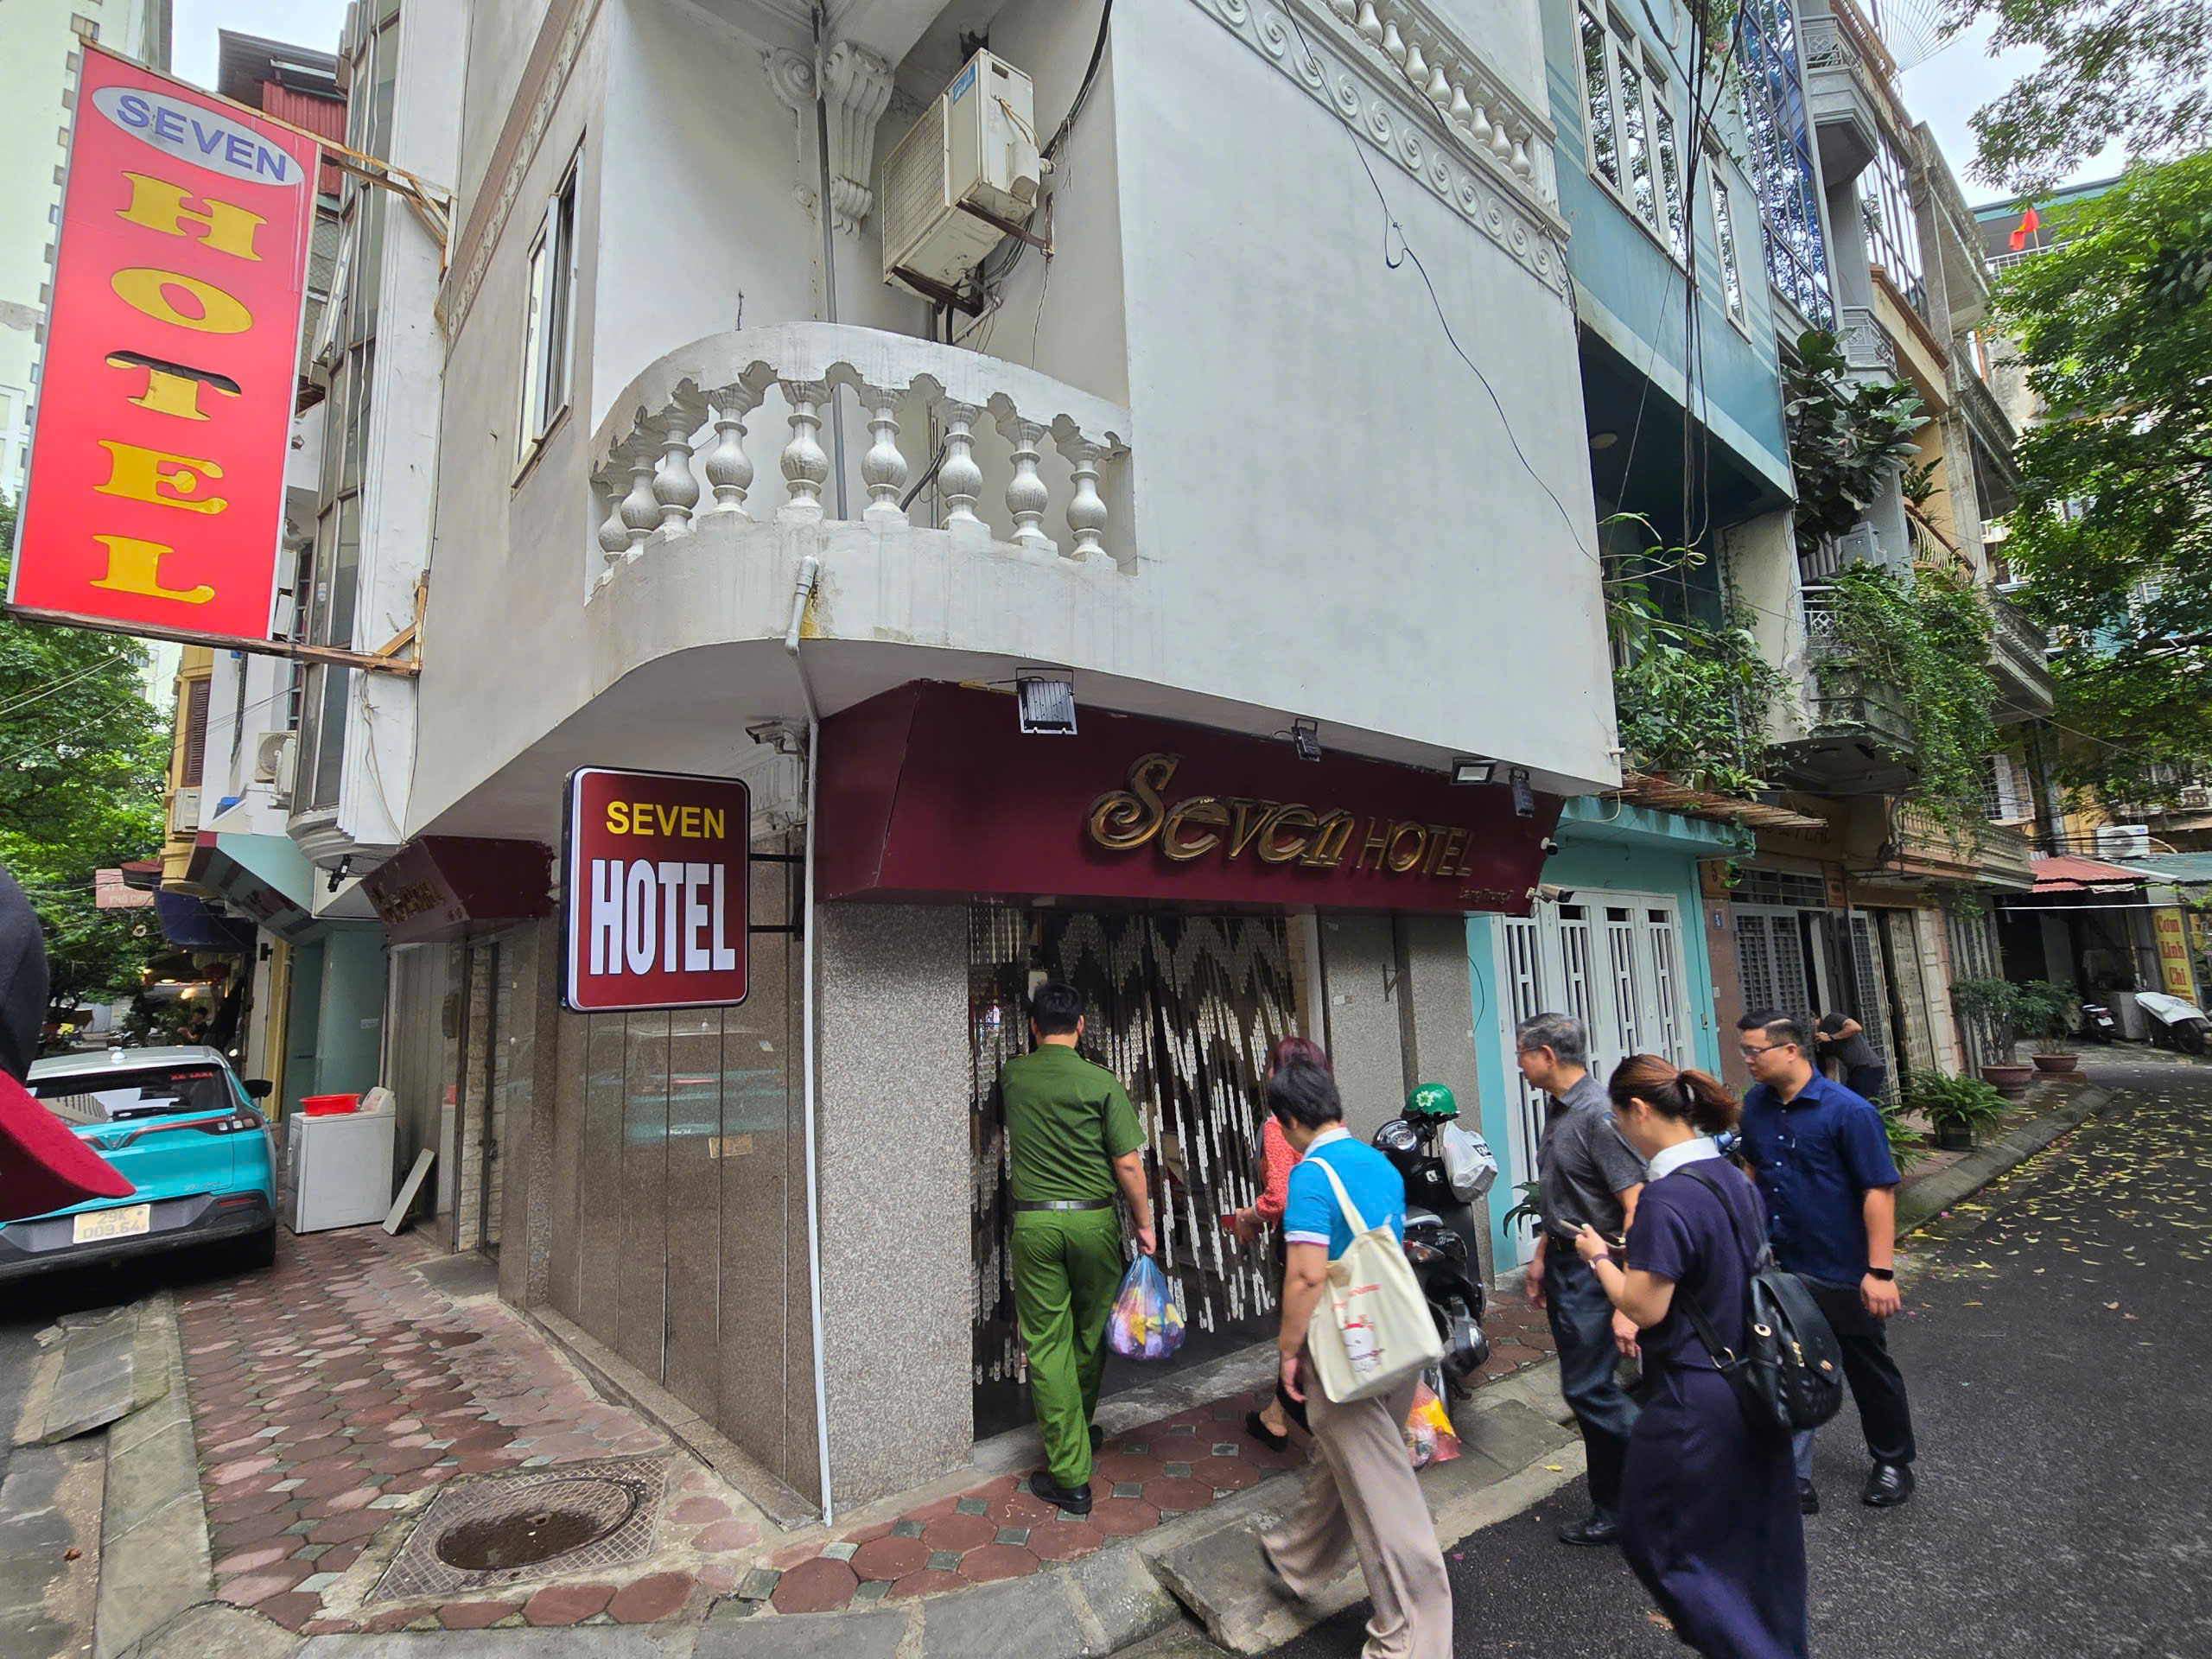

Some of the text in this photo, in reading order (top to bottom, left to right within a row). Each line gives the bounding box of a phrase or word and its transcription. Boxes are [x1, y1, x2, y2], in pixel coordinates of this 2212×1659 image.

[117, 94, 286, 182] SEVEN
[89, 170, 269, 605] HOTEL
[606, 801, 725, 839] SEVEN
[1087, 753, 1472, 876] Seven HOTEL
[589, 859, 735, 976] HOTEL
